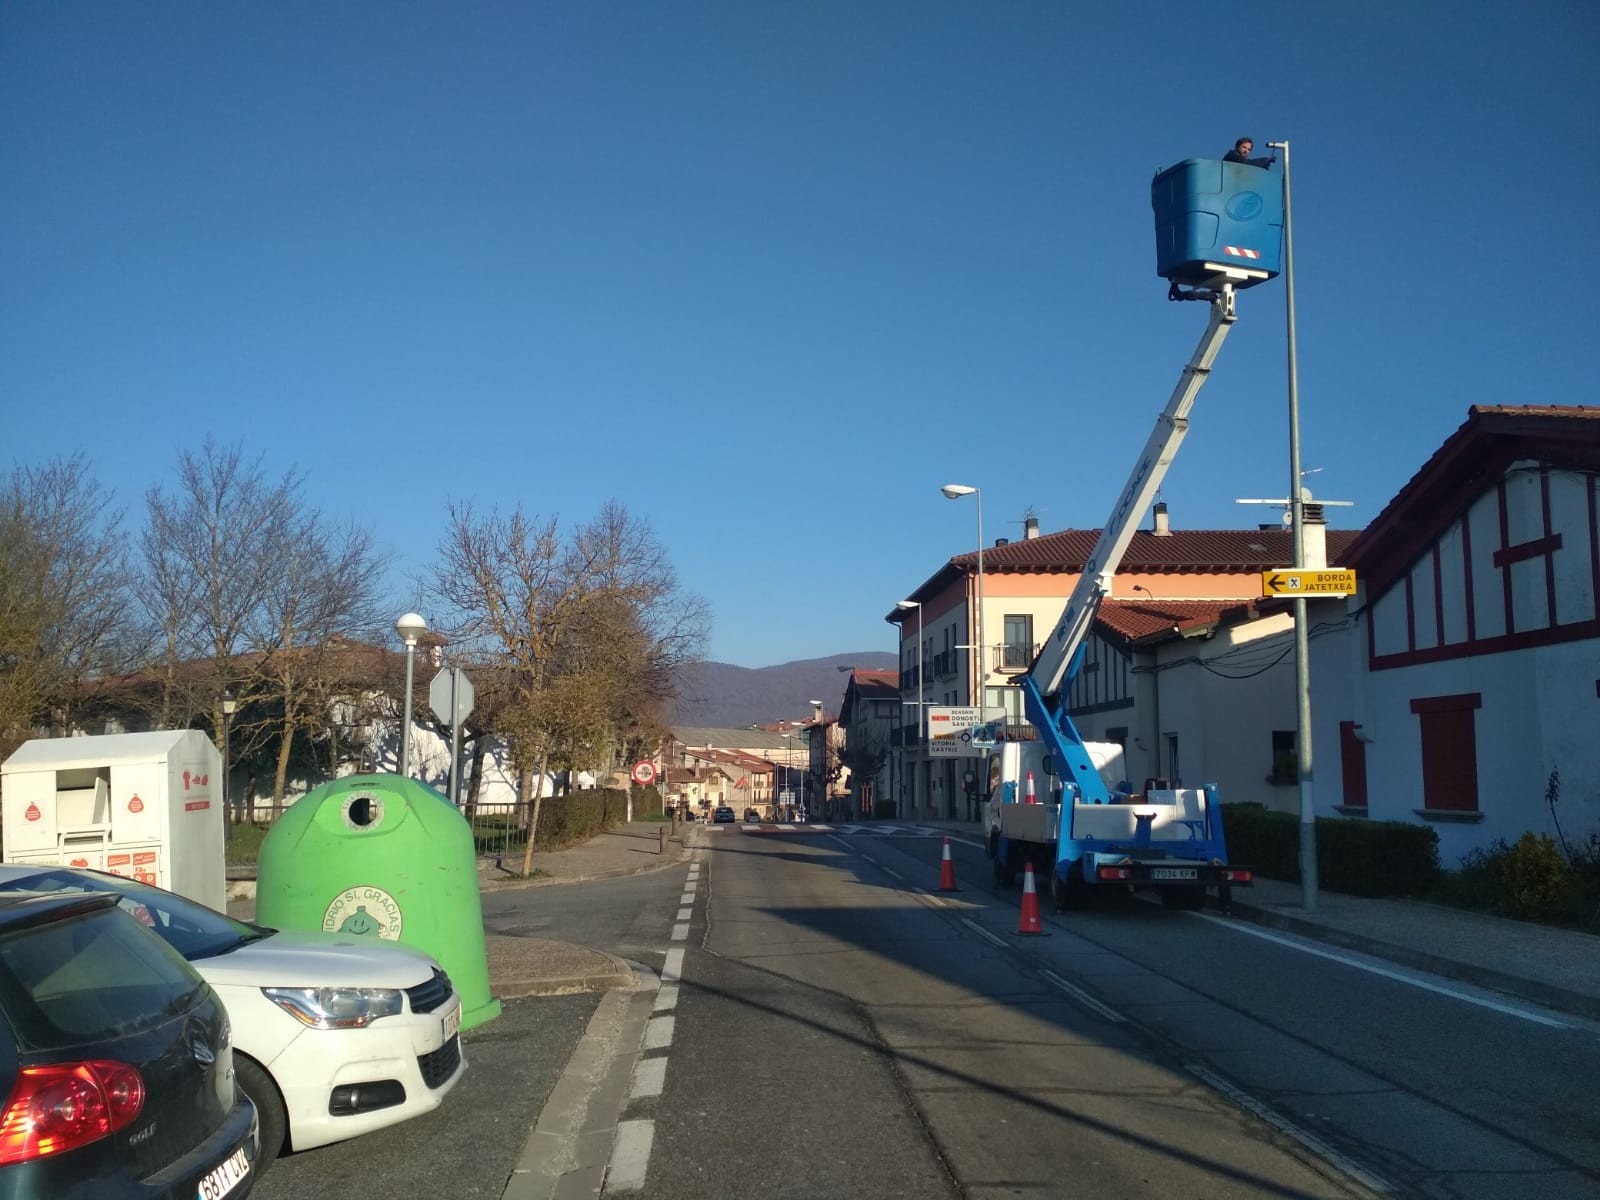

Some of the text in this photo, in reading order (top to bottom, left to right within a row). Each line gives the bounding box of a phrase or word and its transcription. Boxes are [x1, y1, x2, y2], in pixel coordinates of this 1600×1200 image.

[1317, 574, 1353, 582] BORDA
[1304, 583, 1353, 591] JATETXEA
[325, 899, 345, 930] IDRIO
[363, 889, 400, 933] GRACIAS
